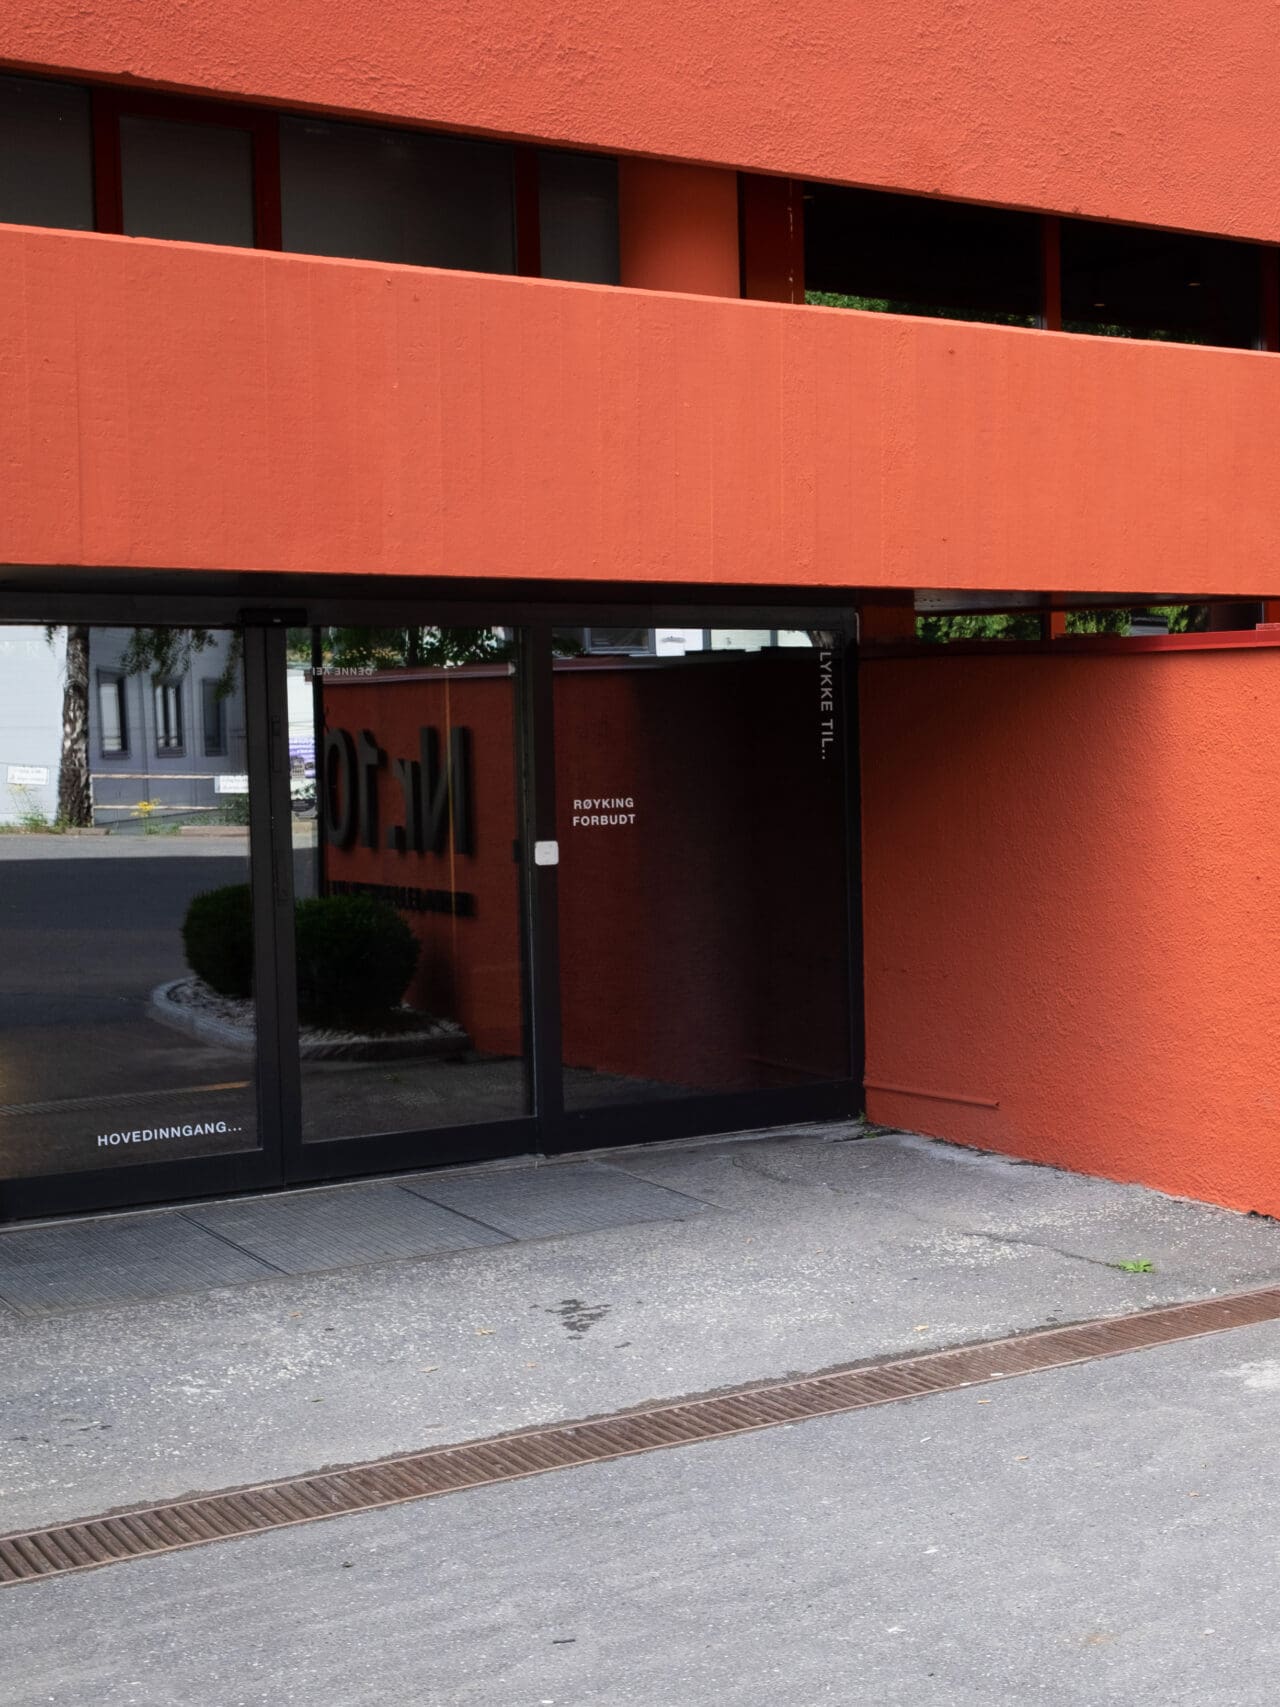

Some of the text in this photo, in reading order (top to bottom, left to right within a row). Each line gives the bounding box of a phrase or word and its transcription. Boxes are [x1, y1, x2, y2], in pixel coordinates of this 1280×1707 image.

[820, 652, 833, 711] LYKKE
[573, 797, 634, 810] RØYKING
[573, 813, 636, 827] FORBUDT
[97, 1121, 242, 1146] HOVEDINNGANG...
